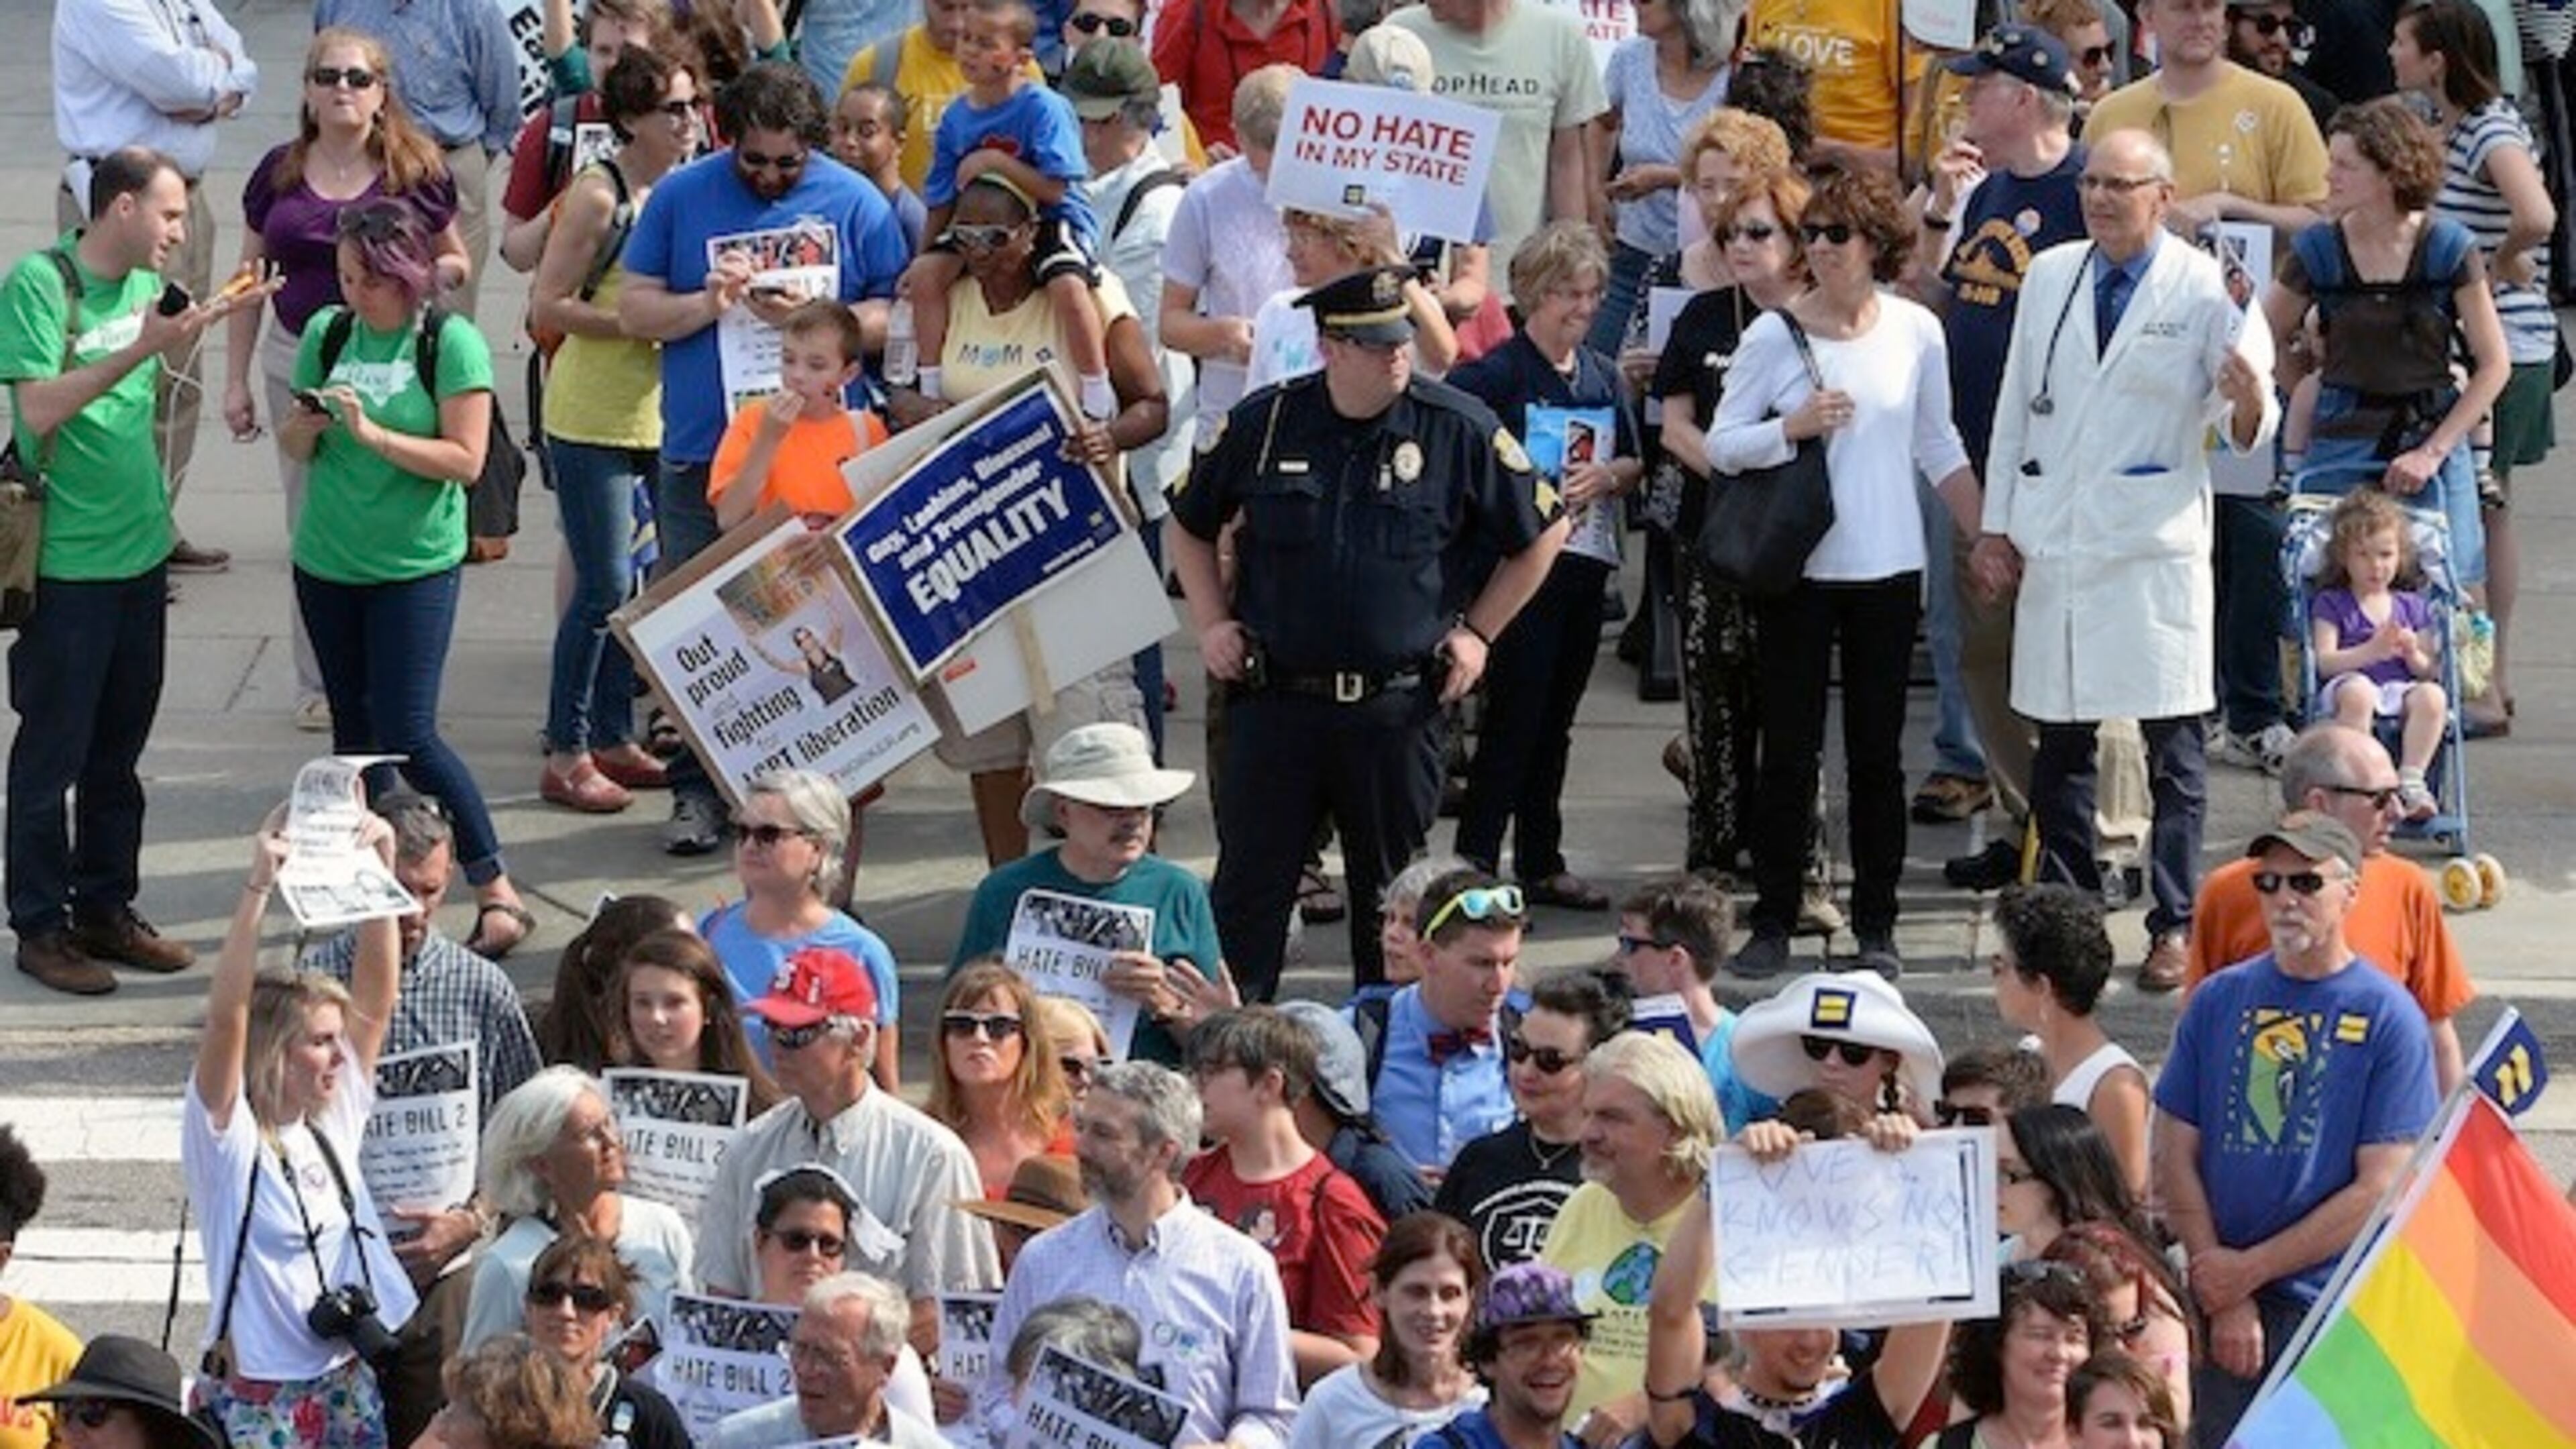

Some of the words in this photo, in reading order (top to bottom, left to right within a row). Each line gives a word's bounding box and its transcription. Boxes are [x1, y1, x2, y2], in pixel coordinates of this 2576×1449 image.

[1432, 74, 1540, 95] OPHEAD
[1302, 104, 1362, 141] NO
[1373, 114, 1474, 161] HATE
[1295, 140, 1326, 164] IN
[1333, 146, 1376, 170] MY
[1384, 150, 1467, 186] STATE
[906, 478, 1069, 614] EQUALITY
[677, 635, 719, 672] Out
[686, 647, 751, 708] proud
[712, 684, 804, 749] fighting
[796, 686, 901, 763] liberation
[1018, 947, 1063, 973] HATE
[365, 1111, 396, 1137] ATE
[405, 1108, 447, 1134] BILL
[456, 1104, 466, 1127] 2
[663, 1132, 704, 1163] BILL
[713, 1139, 727, 1165] 2
[1717, 1144, 1856, 1193] LOVE
[1721, 1192, 1882, 1239] KNOWS
[1901, 1189, 1962, 1230] NO
[672, 1354, 715, 1388] HATE
[724, 1364, 769, 1395] BILL
[779, 1368, 792, 1395] 2
[953, 1352, 987, 1376] HAT
[1025, 1401, 1080, 1445] HATE
